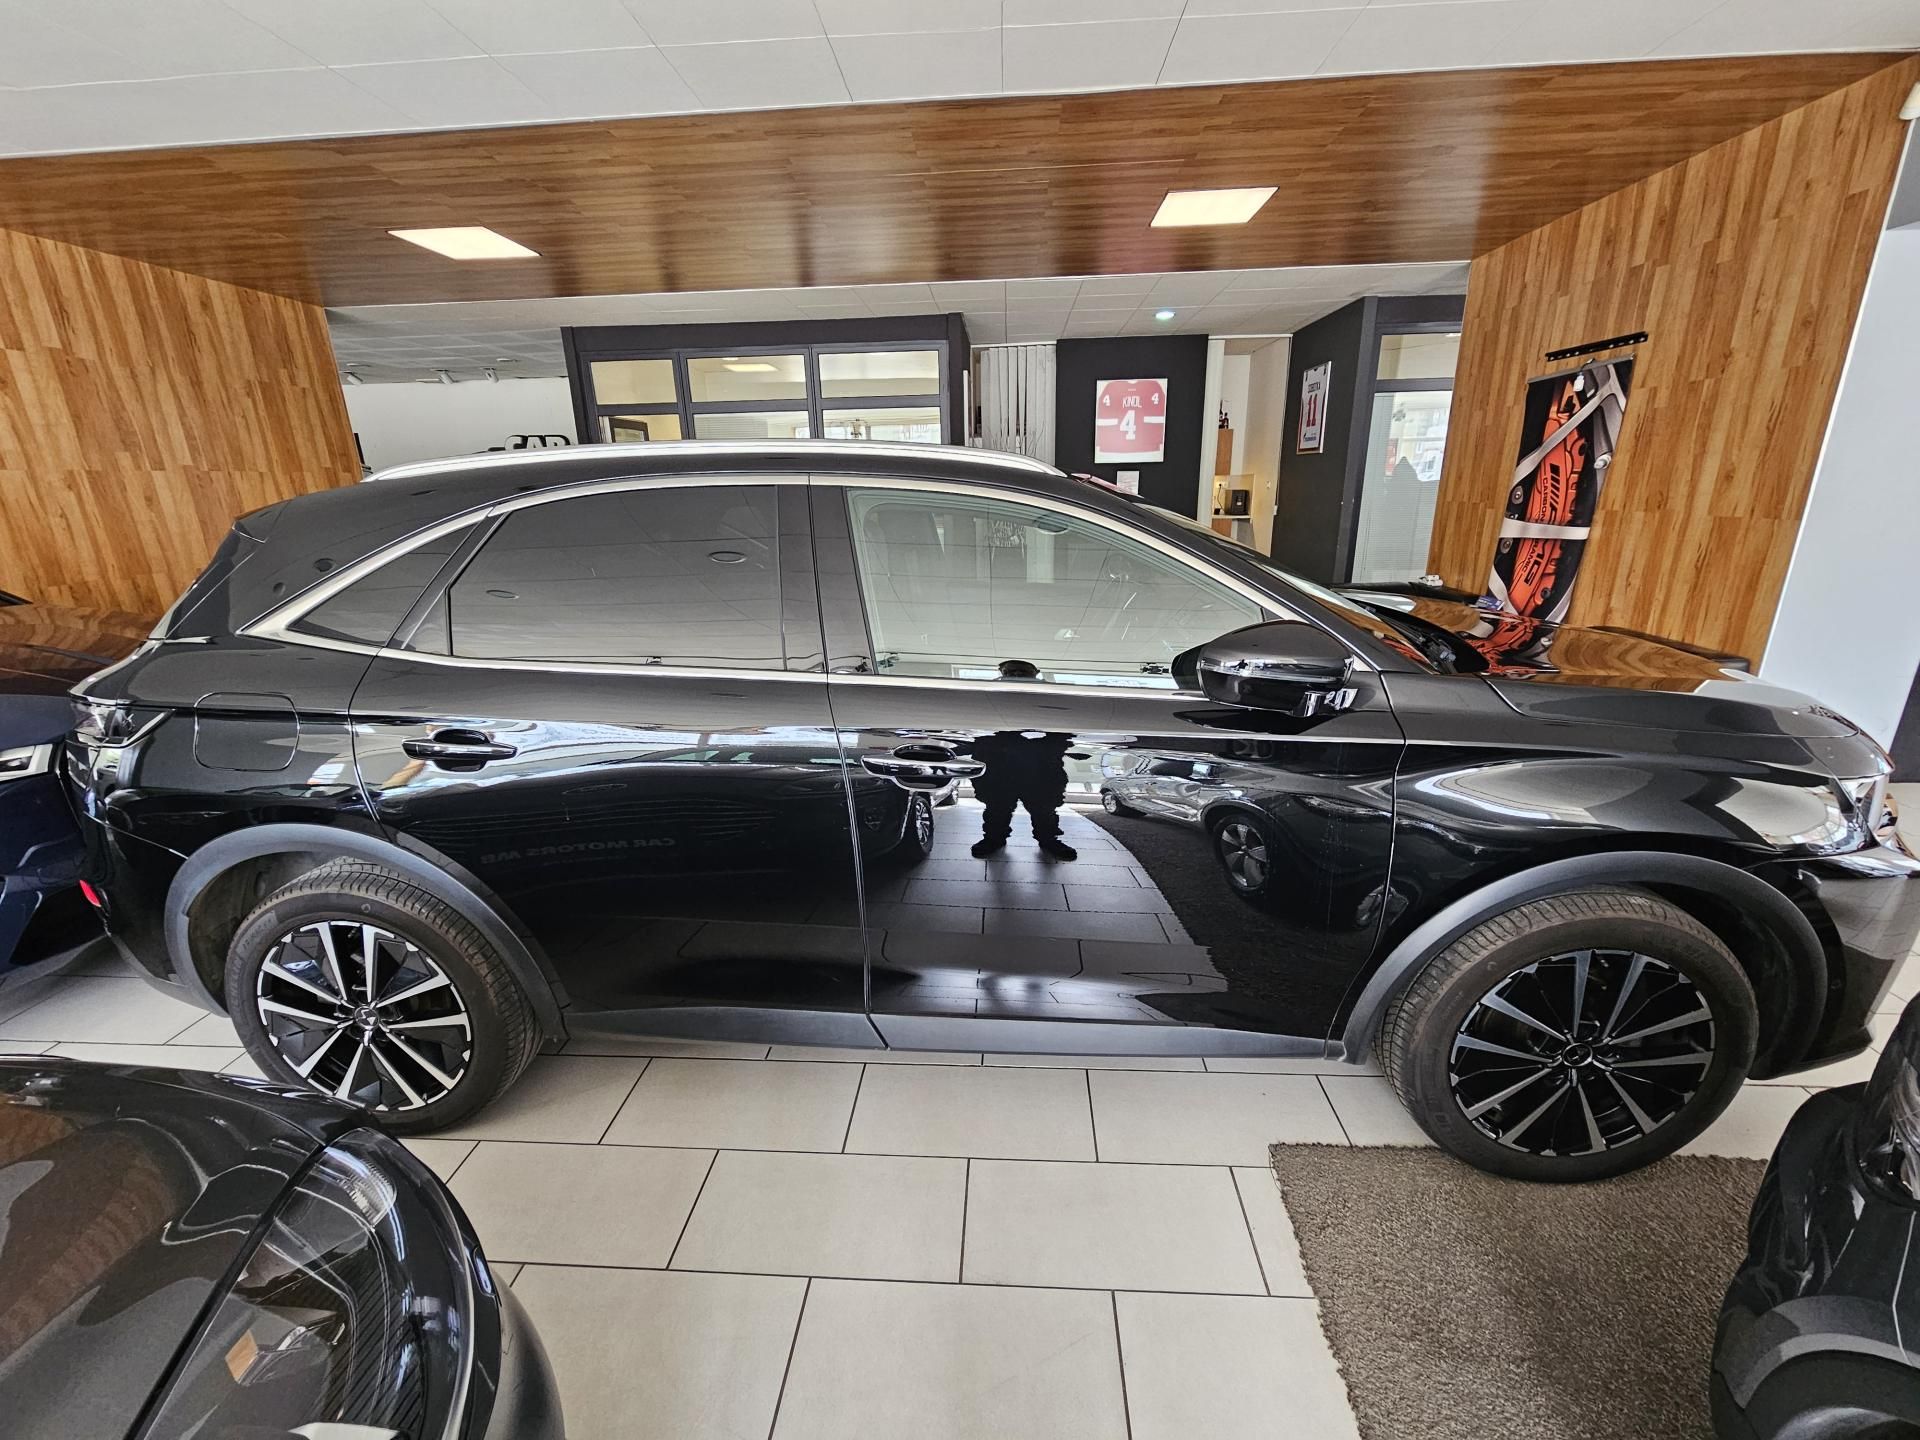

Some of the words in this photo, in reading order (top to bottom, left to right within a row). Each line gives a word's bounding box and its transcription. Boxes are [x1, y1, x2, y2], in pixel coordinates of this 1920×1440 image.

[1103, 394, 1110, 406] 4
[1151, 392, 1159, 404] 4
[1306, 393, 1318, 427] 11
[1120, 409, 1136, 439] 4
[1538, 477, 1549, 522] CARBON
